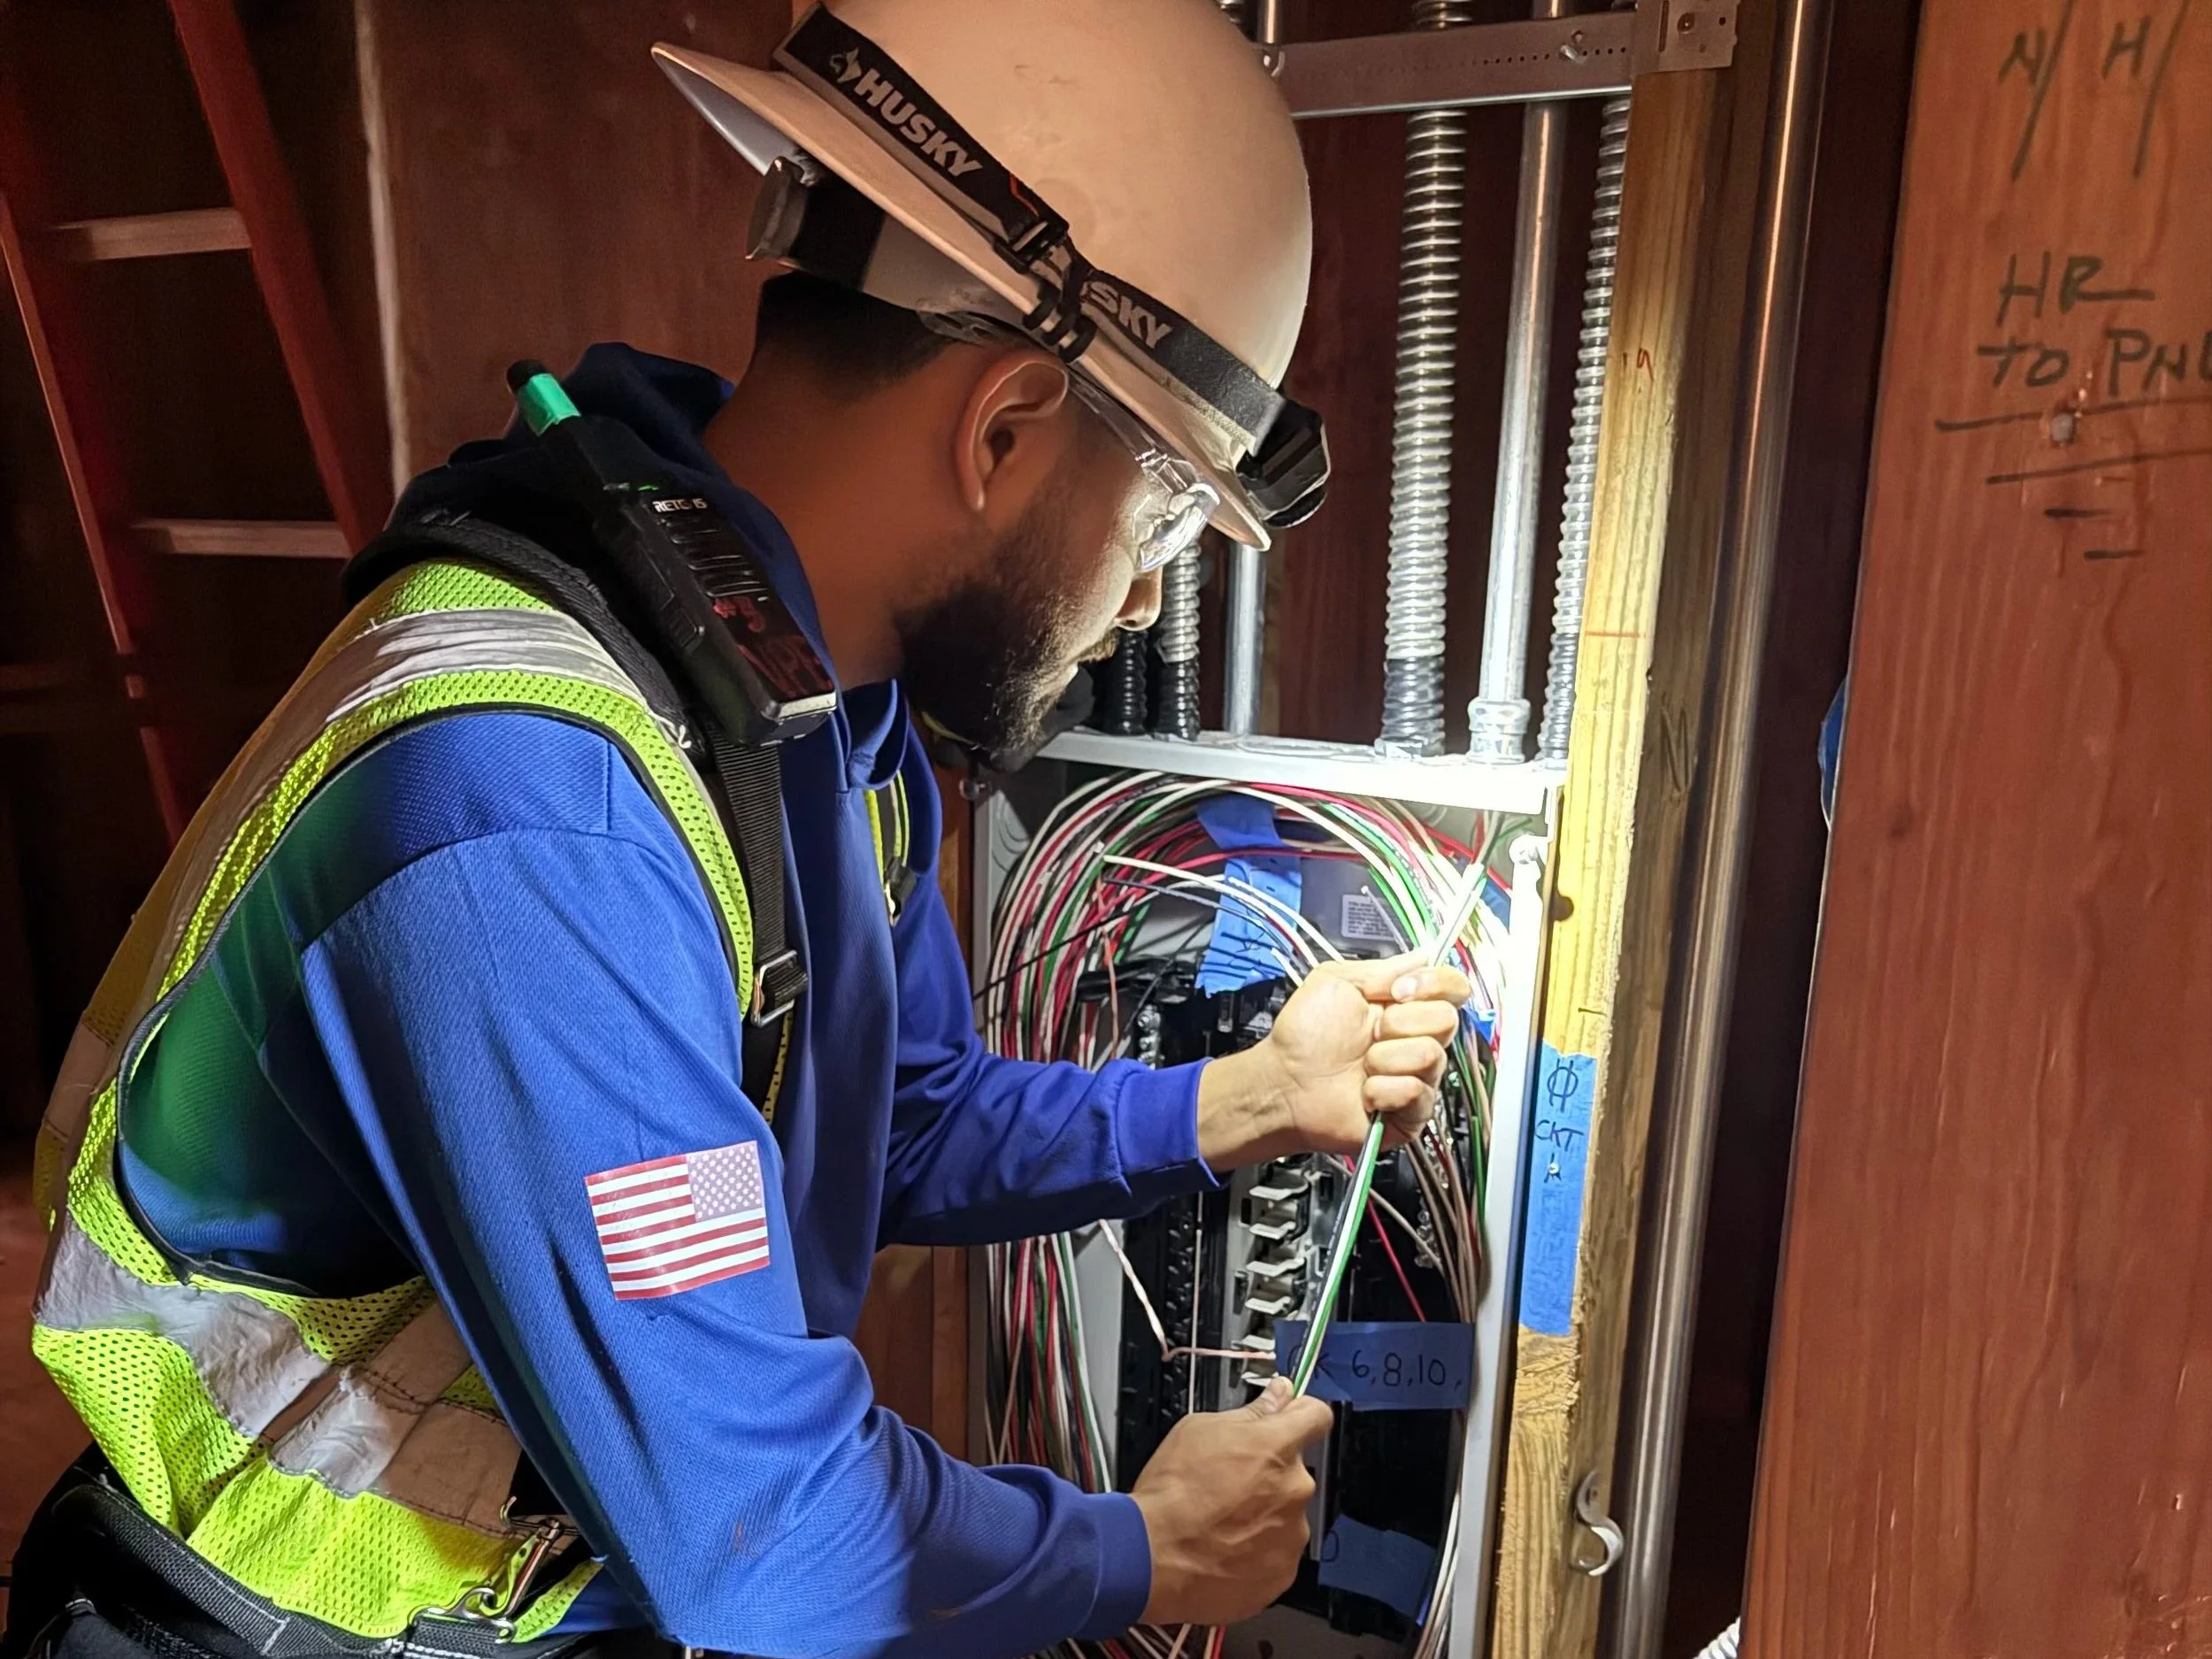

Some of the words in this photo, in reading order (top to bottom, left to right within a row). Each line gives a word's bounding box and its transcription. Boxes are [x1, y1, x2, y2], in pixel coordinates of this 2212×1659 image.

[854, 68, 983, 177] HUSKY
[1080, 281, 1172, 349] SKY
[652, 497, 708, 512] RETEIS
[1534, 1118, 1585, 1152] CKT
